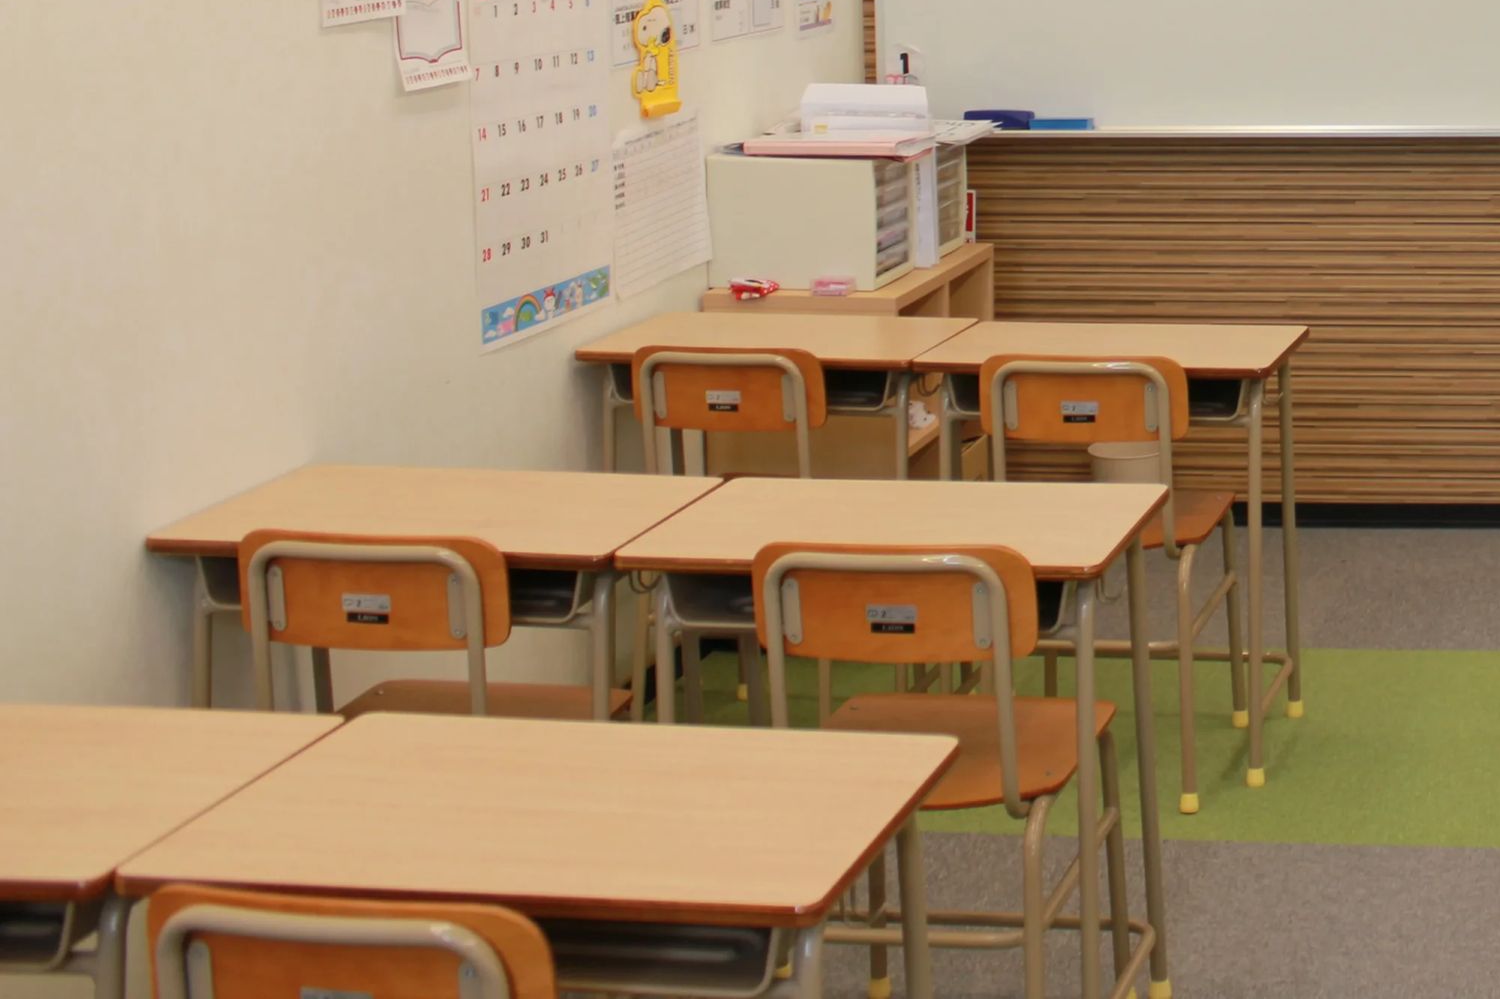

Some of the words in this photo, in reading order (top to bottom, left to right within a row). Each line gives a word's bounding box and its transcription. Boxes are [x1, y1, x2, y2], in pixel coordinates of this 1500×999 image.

[534, 58, 543, 71] 10
[552, 55, 560, 68] 11
[570, 52, 578, 65] 12
[900, 52, 909, 74] 1
[478, 127, 487, 141] 14
[498, 123, 507, 137] 15
[518, 119, 527, 133] 16
[536, 115, 544, 128] 17
[555, 111, 563, 125] 18
[573, 108, 580, 121] 19
[481, 187, 490, 202] 21
[501, 182, 511, 197] 22
[520, 178, 530, 192] 23
[540, 172, 549, 187] 24
[558, 167, 567, 182] 25
[575, 163, 583, 177] 26
[482, 247, 492, 262] 28
[502, 241, 511, 256] 29
[521, 235, 531, 250] 30
[540, 229, 549, 244] 31
